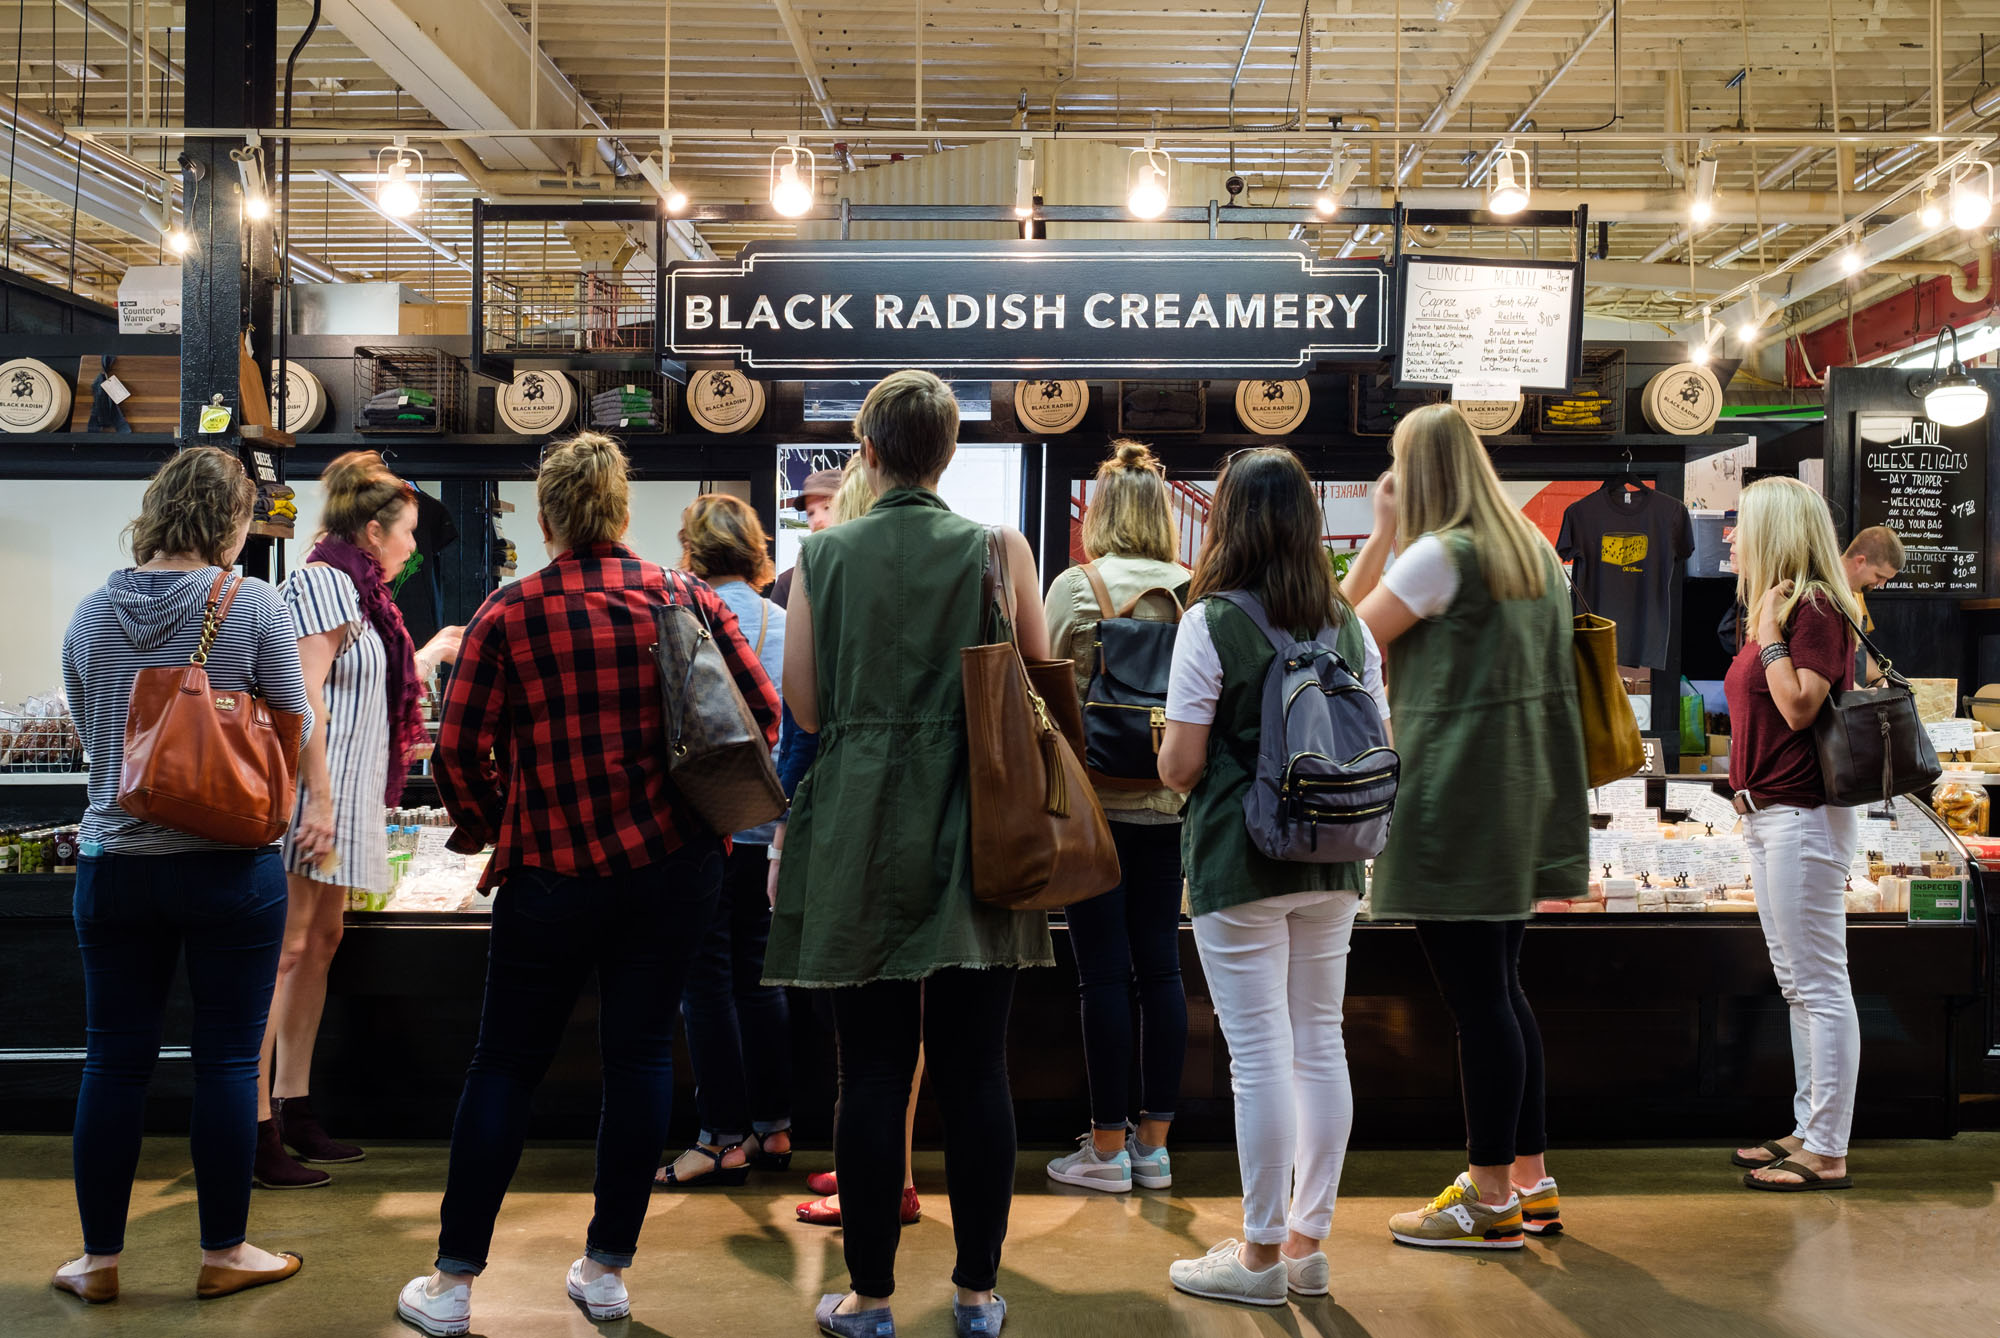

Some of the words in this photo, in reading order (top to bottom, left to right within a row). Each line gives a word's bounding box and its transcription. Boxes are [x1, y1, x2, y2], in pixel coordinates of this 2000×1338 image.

[1428, 266, 1474, 283] LUNCH
[1494, 269, 1537, 287] MENU
[1418, 291, 1457, 311] Caprese
[123, 307, 166, 316] Countertop
[685, 294, 853, 330] BLACK
[874, 294, 1065, 330] RADISH
[1083, 293, 1367, 330] CREAMERY
[1421, 309, 1441, 318] Grilled
[1498, 311, 1525, 320] Raclette
[1521, 328, 1537, 338] wheel
[705, 404, 724, 412] BLACK
[725, 398, 747, 407] RADISH
[1663, 396, 1681, 409] BLACK
[1681, 405, 1700, 420] RADISH
[1901, 422, 1940, 445] MENU
[1867, 452, 1915, 469] CHEESE
[1920, 453, 1968, 470] FLIGHTS
[1903, 486, 1919, 495] Ohio
[1890, 497, 1942, 508] WEEKENDER
[1908, 519, 1926, 529] YOUR
[1927, 519, 1943, 529] BAG
[1923, 553, 1947, 563] CHEESE
[1917, 581, 1946, 589] WED-SAT
[1913, 883, 1958, 891] INSPECTED
